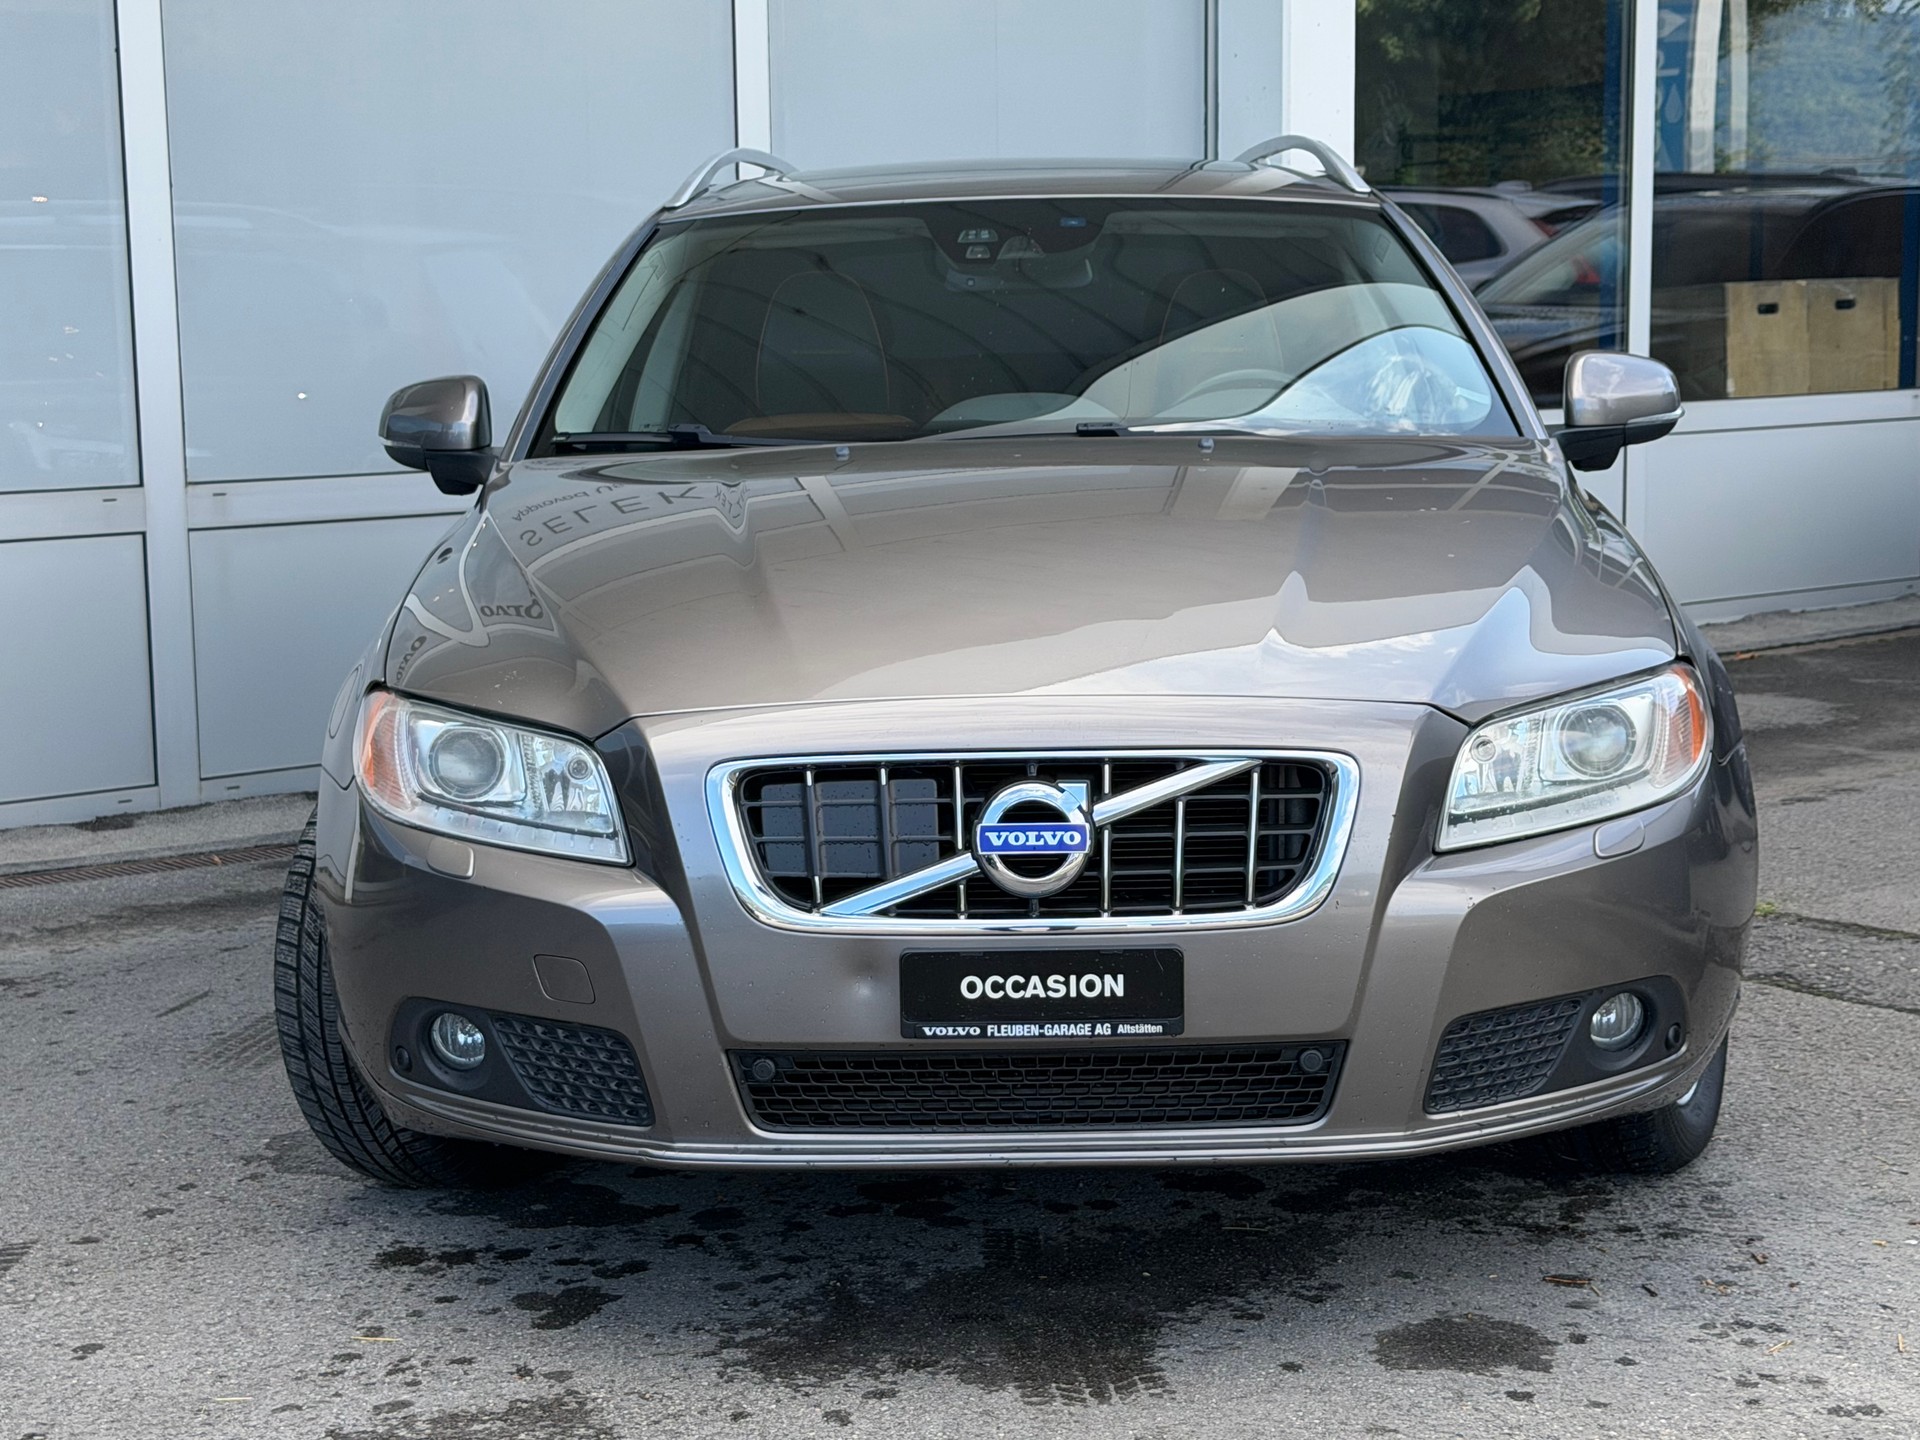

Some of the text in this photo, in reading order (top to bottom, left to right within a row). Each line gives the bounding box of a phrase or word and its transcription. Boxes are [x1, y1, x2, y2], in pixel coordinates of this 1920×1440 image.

[984, 831, 1082, 846] VOLVO
[960, 973, 1124, 999] OCCASION
[922, 1022, 1163, 1037] VOLVO FLEUBEN-GARAGE AG Altstätten
